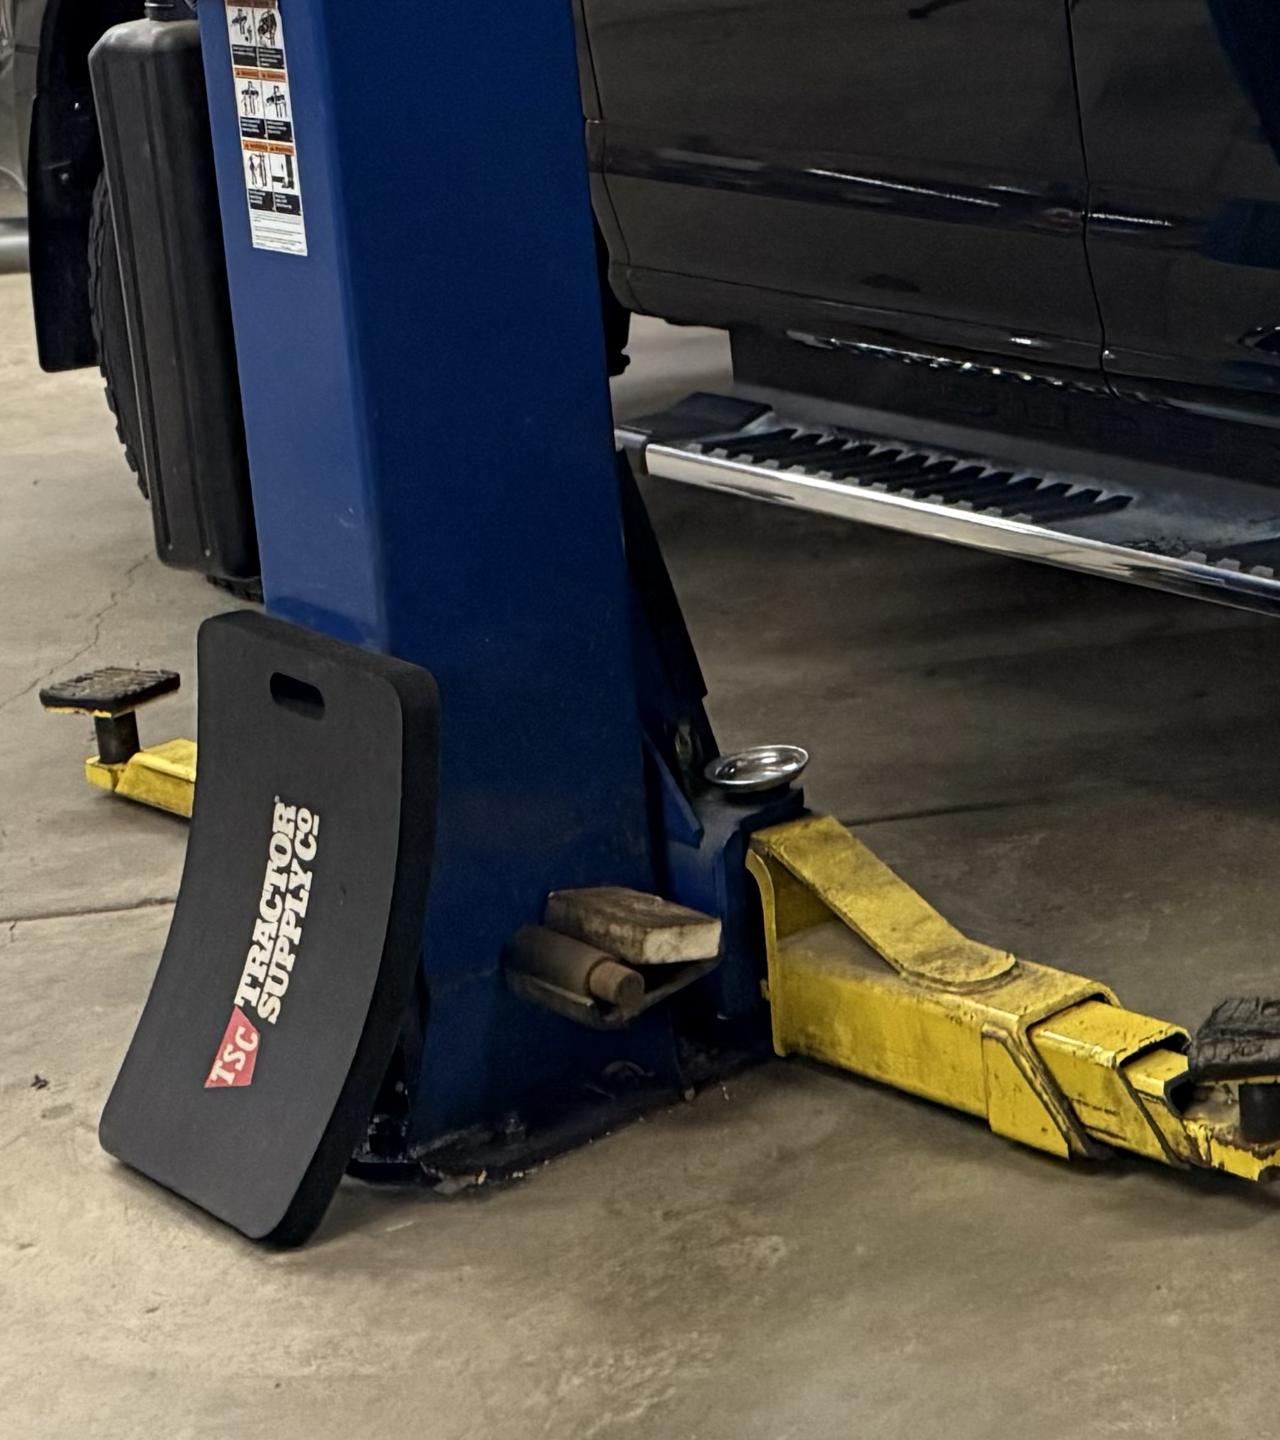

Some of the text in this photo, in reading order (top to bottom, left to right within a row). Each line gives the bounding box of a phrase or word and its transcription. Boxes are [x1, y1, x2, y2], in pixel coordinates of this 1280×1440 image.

[233, 801, 297, 1008] TRACTOR
[257, 858, 313, 1025] SUPPLY
[208, 1025, 259, 1086] TSC
